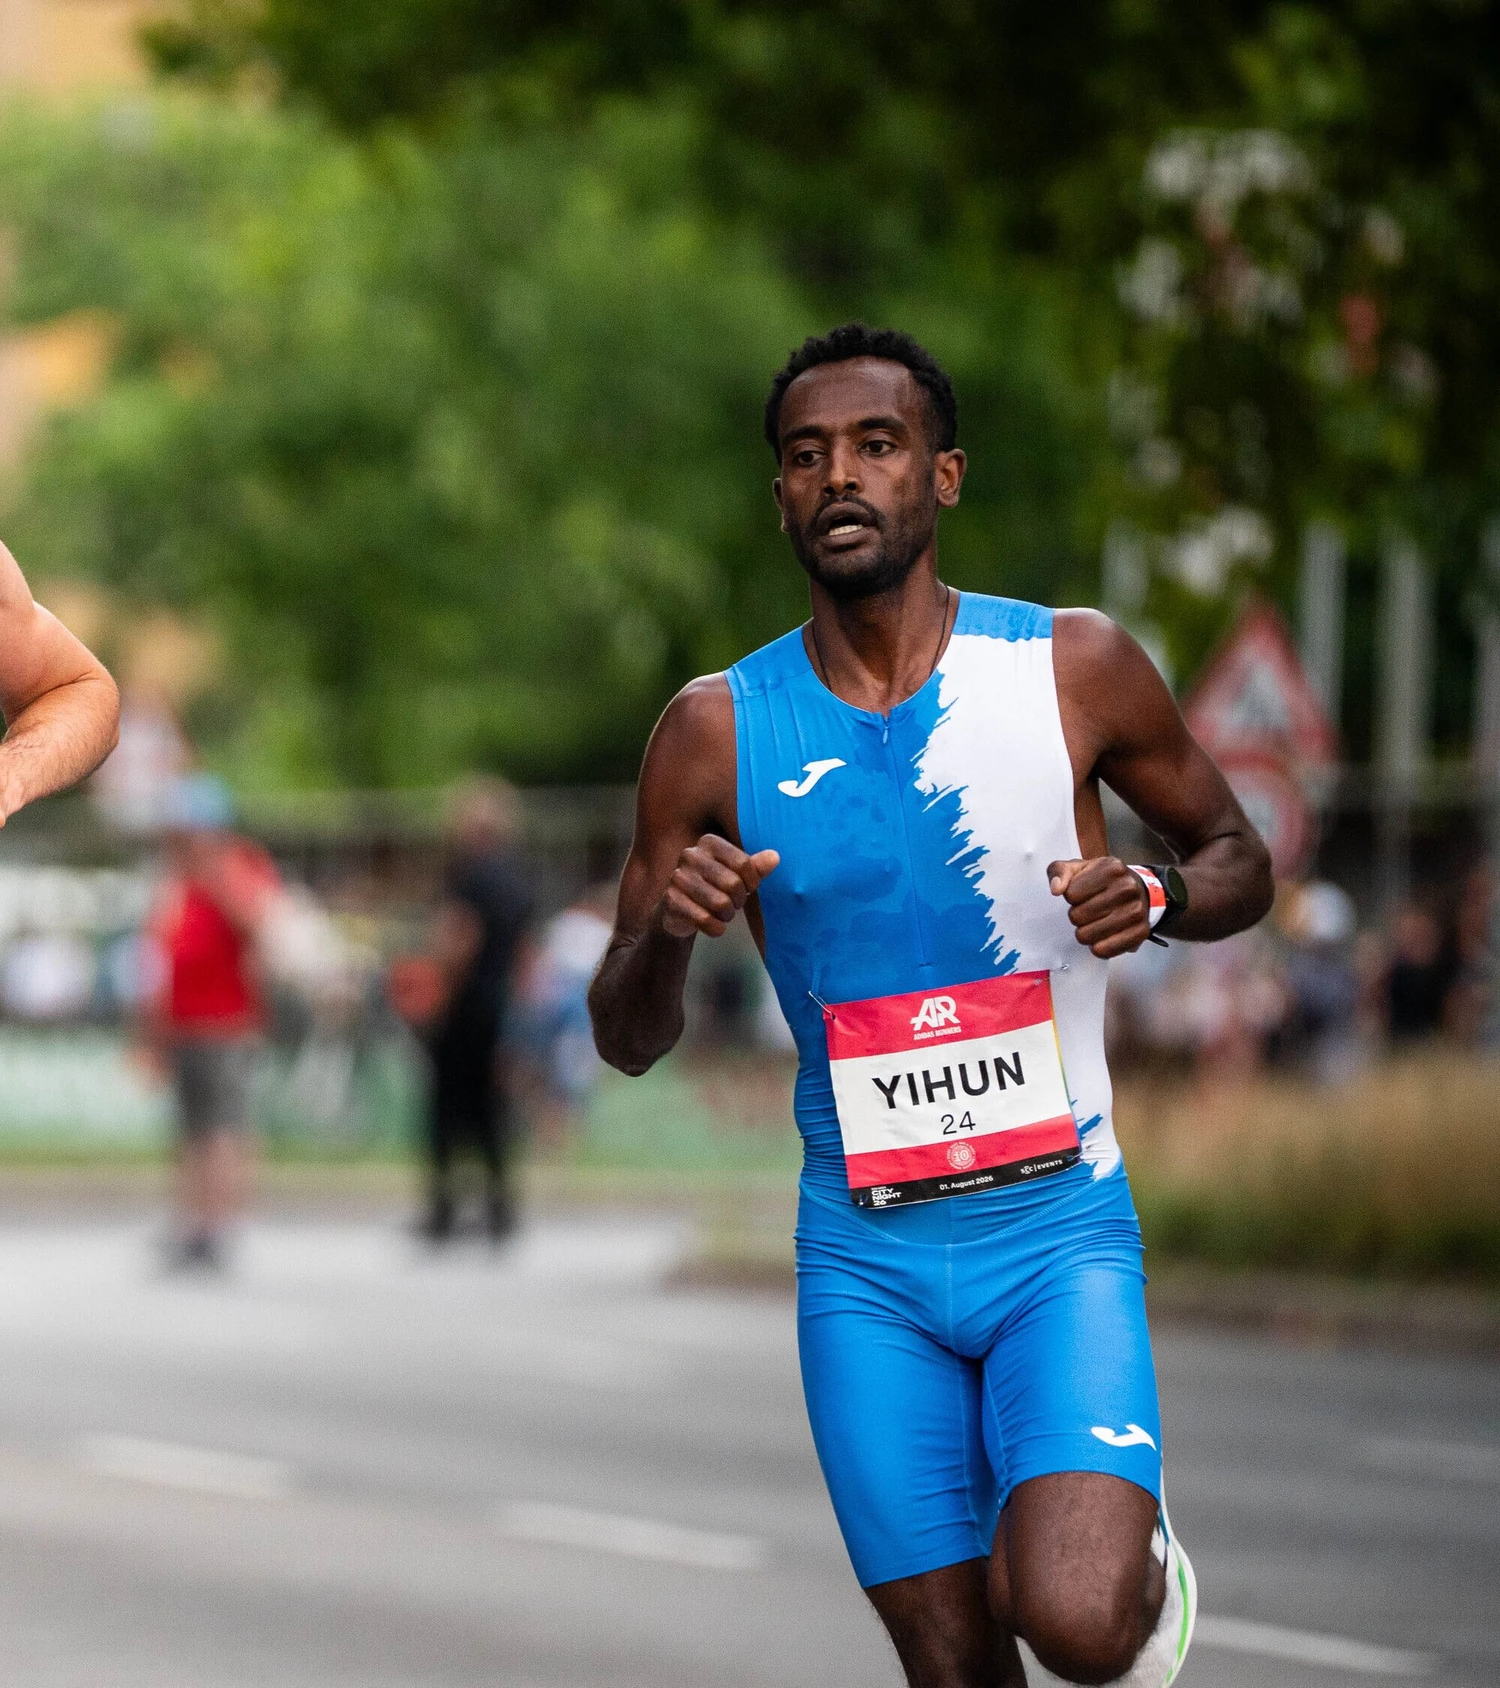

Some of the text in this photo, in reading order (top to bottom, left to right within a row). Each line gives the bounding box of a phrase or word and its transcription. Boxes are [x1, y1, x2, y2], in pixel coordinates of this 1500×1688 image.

[910, 995, 961, 1031] AR
[913, 1026, 962, 1041] ADIDAS RUNNERS
[871, 1051, 1025, 1109] YIHUN
[940, 1110, 976, 1136] 24
[950, 1179, 975, 1189] August
[975, 1175, 994, 1184] 2026
[871, 1188, 893, 1196] CITY
[872, 1191, 902, 1201] NIGHT
